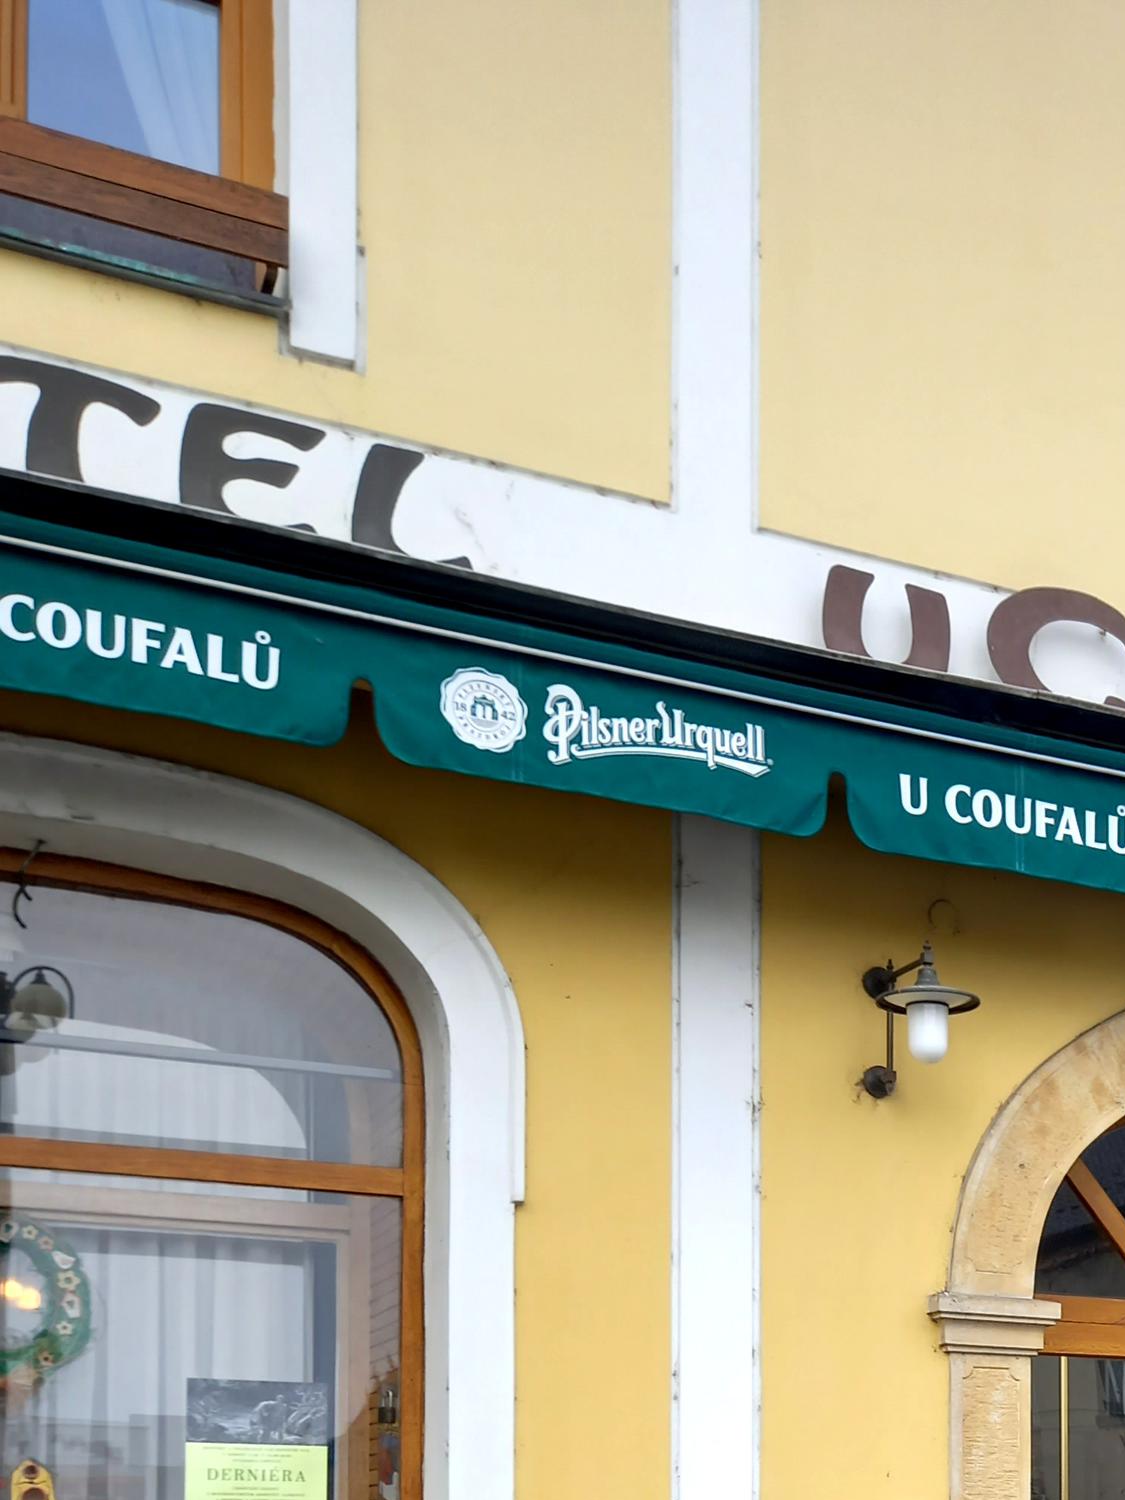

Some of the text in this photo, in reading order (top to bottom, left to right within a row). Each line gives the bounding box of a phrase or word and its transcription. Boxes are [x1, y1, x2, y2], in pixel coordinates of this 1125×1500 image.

[0, 593, 281, 690] COUFALŮ
[543, 684, 766, 770] Pilsner Urquell
[899, 773, 927, 816] U
[207, 1466, 306, 1482] DERNIÉRA
